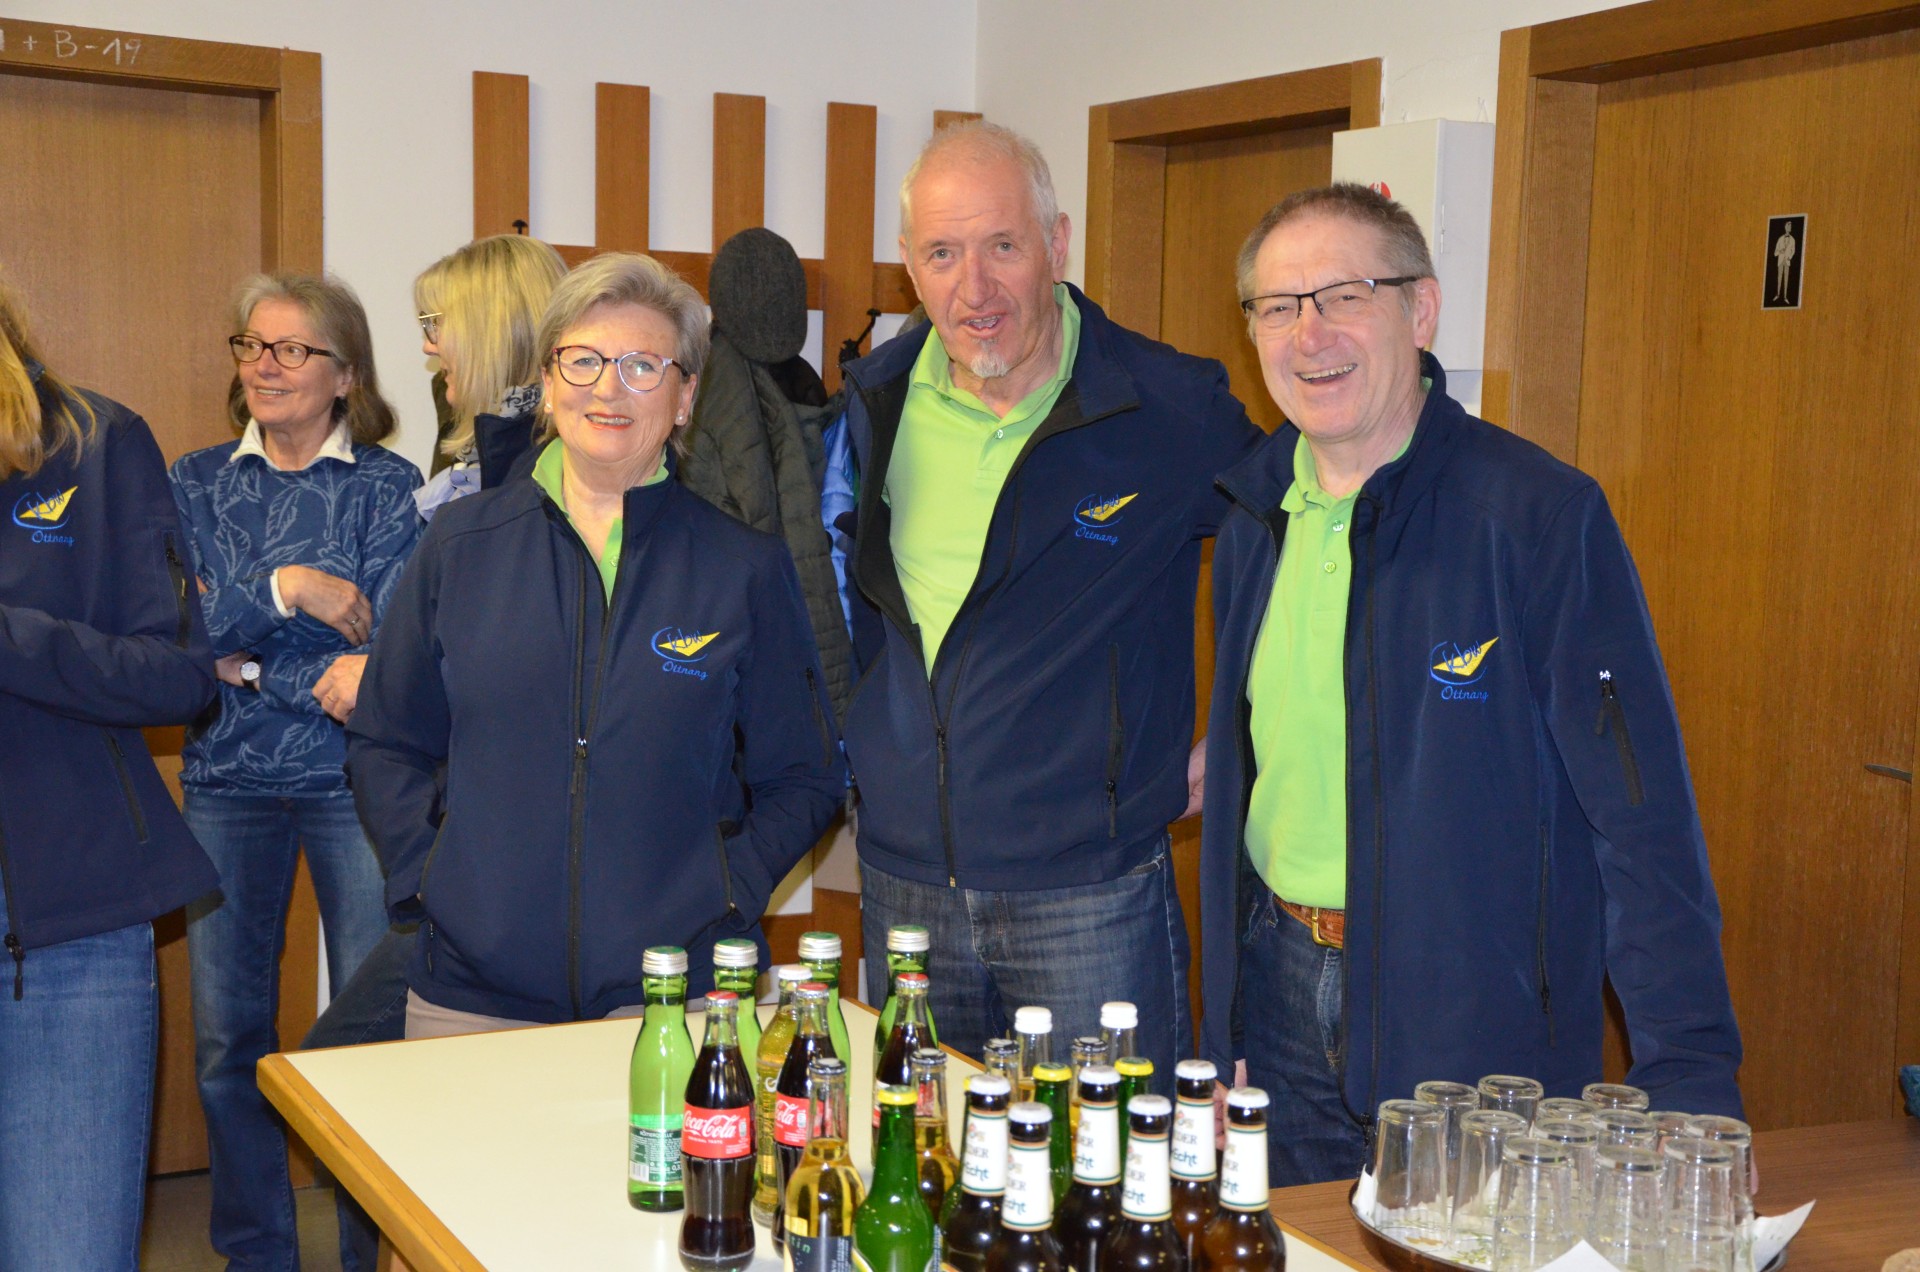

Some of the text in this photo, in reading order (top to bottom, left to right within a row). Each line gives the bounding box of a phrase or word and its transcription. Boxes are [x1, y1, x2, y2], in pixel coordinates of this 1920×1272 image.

[31, 530, 75, 547] Ottnang
[1075, 526, 1119, 546] Ottnang
[662, 660, 708, 681] Ottnang
[1441, 685, 1489, 704] Ottnang
